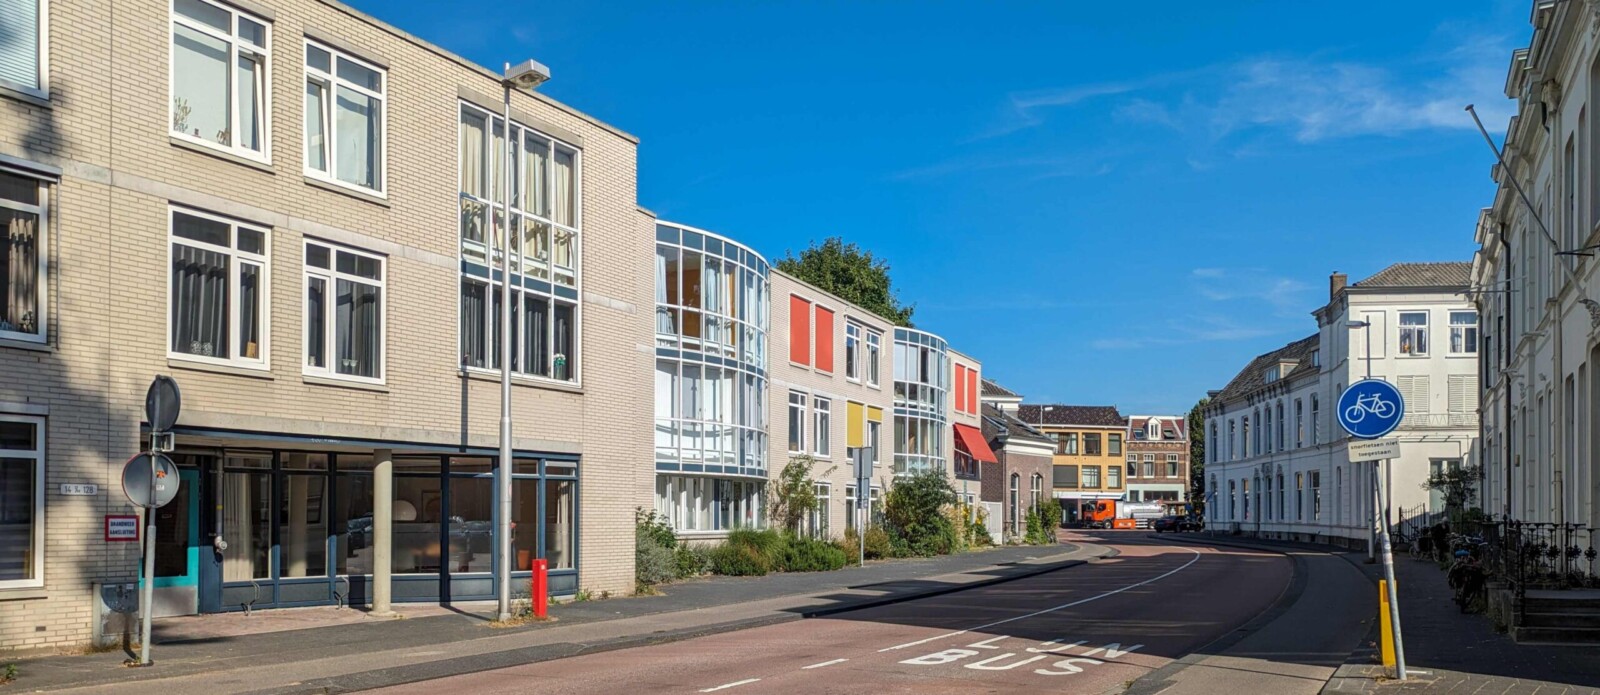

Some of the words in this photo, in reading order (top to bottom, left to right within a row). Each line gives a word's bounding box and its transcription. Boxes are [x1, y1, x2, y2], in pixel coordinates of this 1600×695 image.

[1350, 442, 1384, 450] snorfietsen
[64, 485, 72, 494] 14
[83, 485, 94, 494] 128
[897, 648, 1105, 675] BUS
